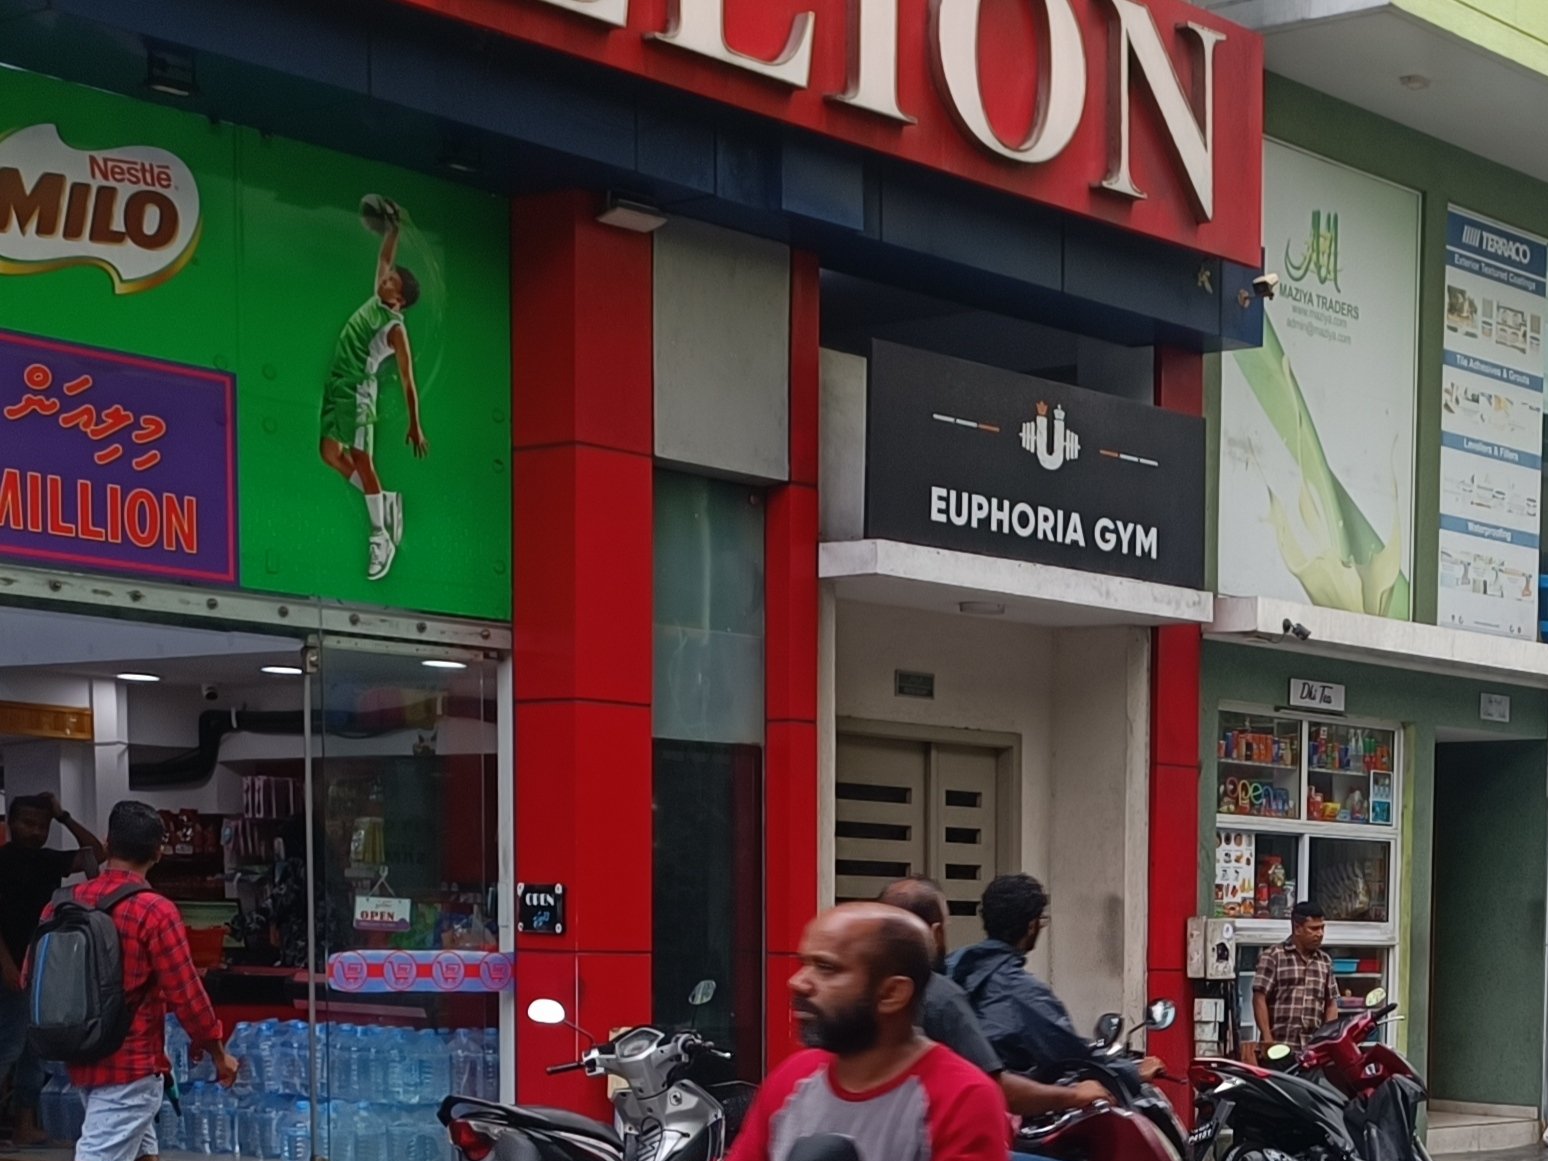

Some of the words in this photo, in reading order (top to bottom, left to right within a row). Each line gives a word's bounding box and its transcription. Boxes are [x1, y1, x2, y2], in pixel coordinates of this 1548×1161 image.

[535, 0, 1227, 223] ION
[0, 166, 180, 251] MILO
[1482, 231, 1531, 265] TERRACO
[1280, 283, 1315, 307] MAZIYA
[1316, 294, 1360, 320] TRADERS
[931, 486, 1086, 548] EUPHORIA
[1094, 517, 1159, 560] GYM
[360, 910, 395, 921] OPEN
